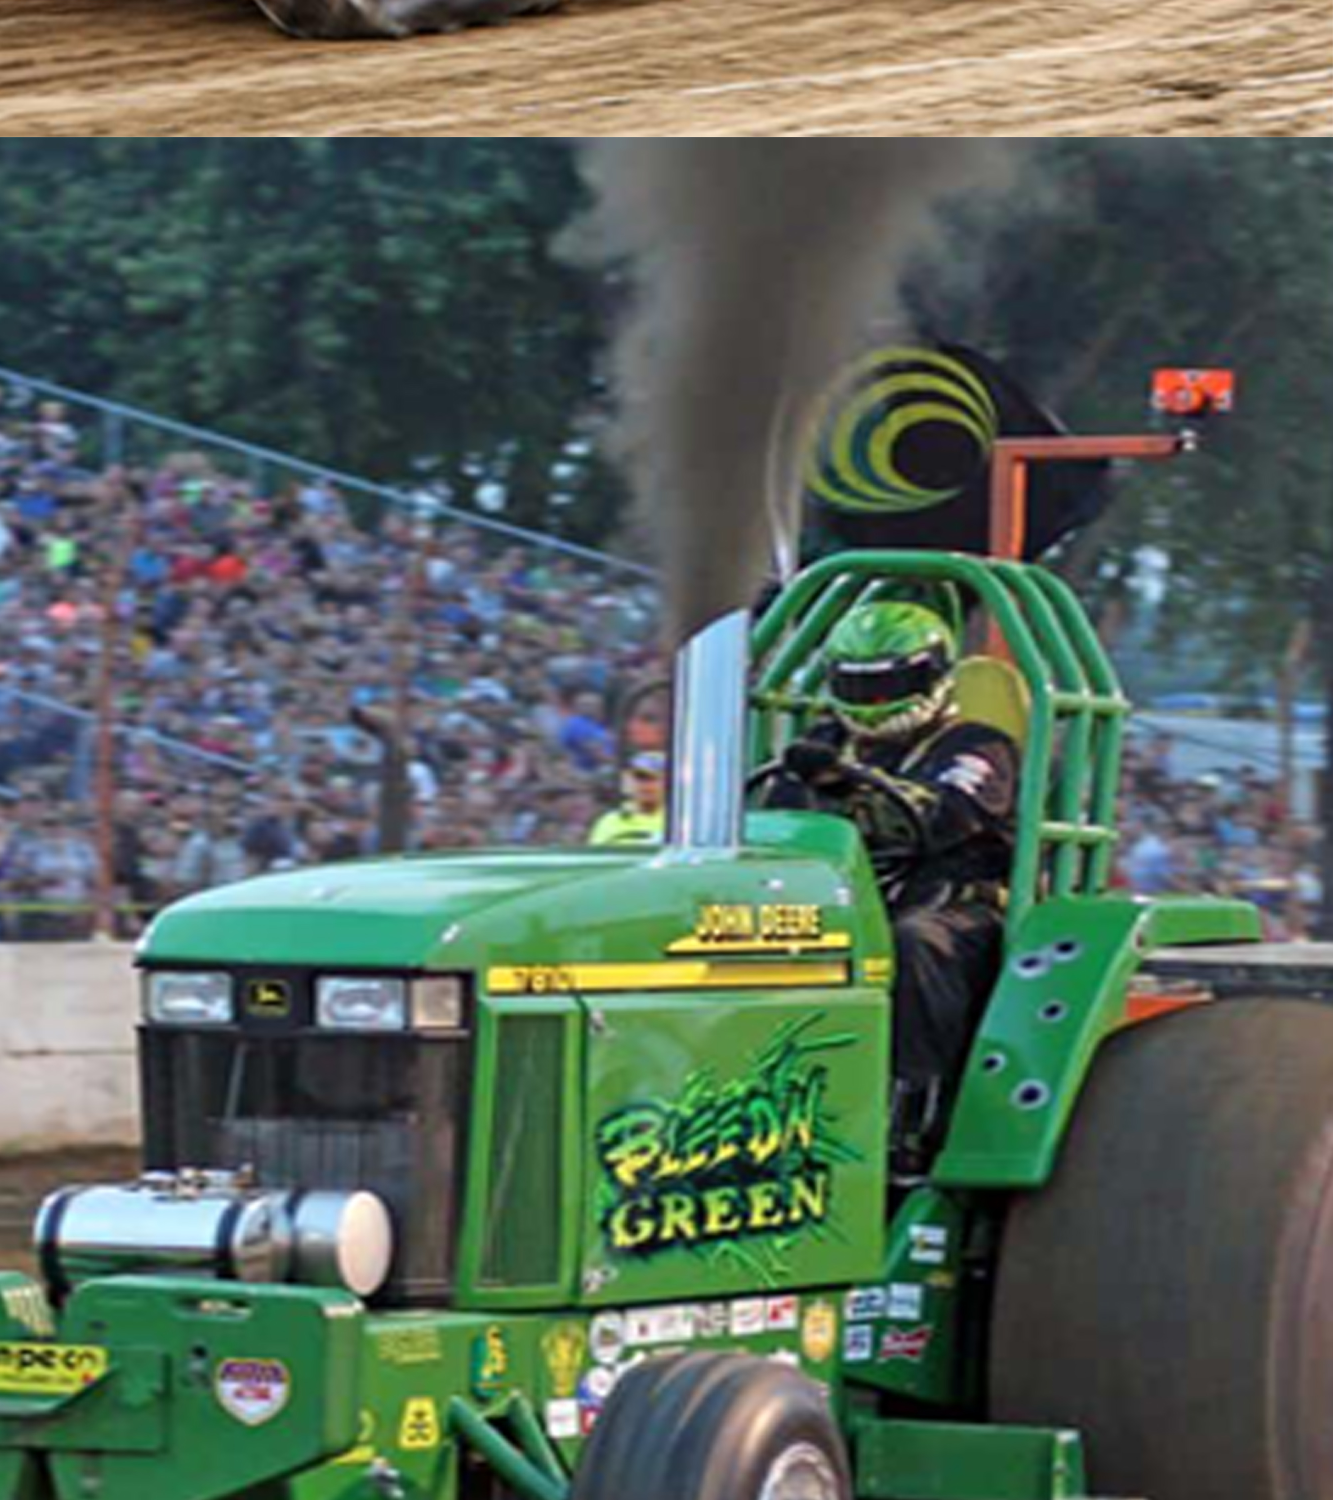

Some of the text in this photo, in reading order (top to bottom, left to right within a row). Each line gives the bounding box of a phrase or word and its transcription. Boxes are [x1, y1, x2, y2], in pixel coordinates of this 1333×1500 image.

[697, 903, 822, 941] JOHN DEERE
[608, 1171, 826, 1248] GREEN
